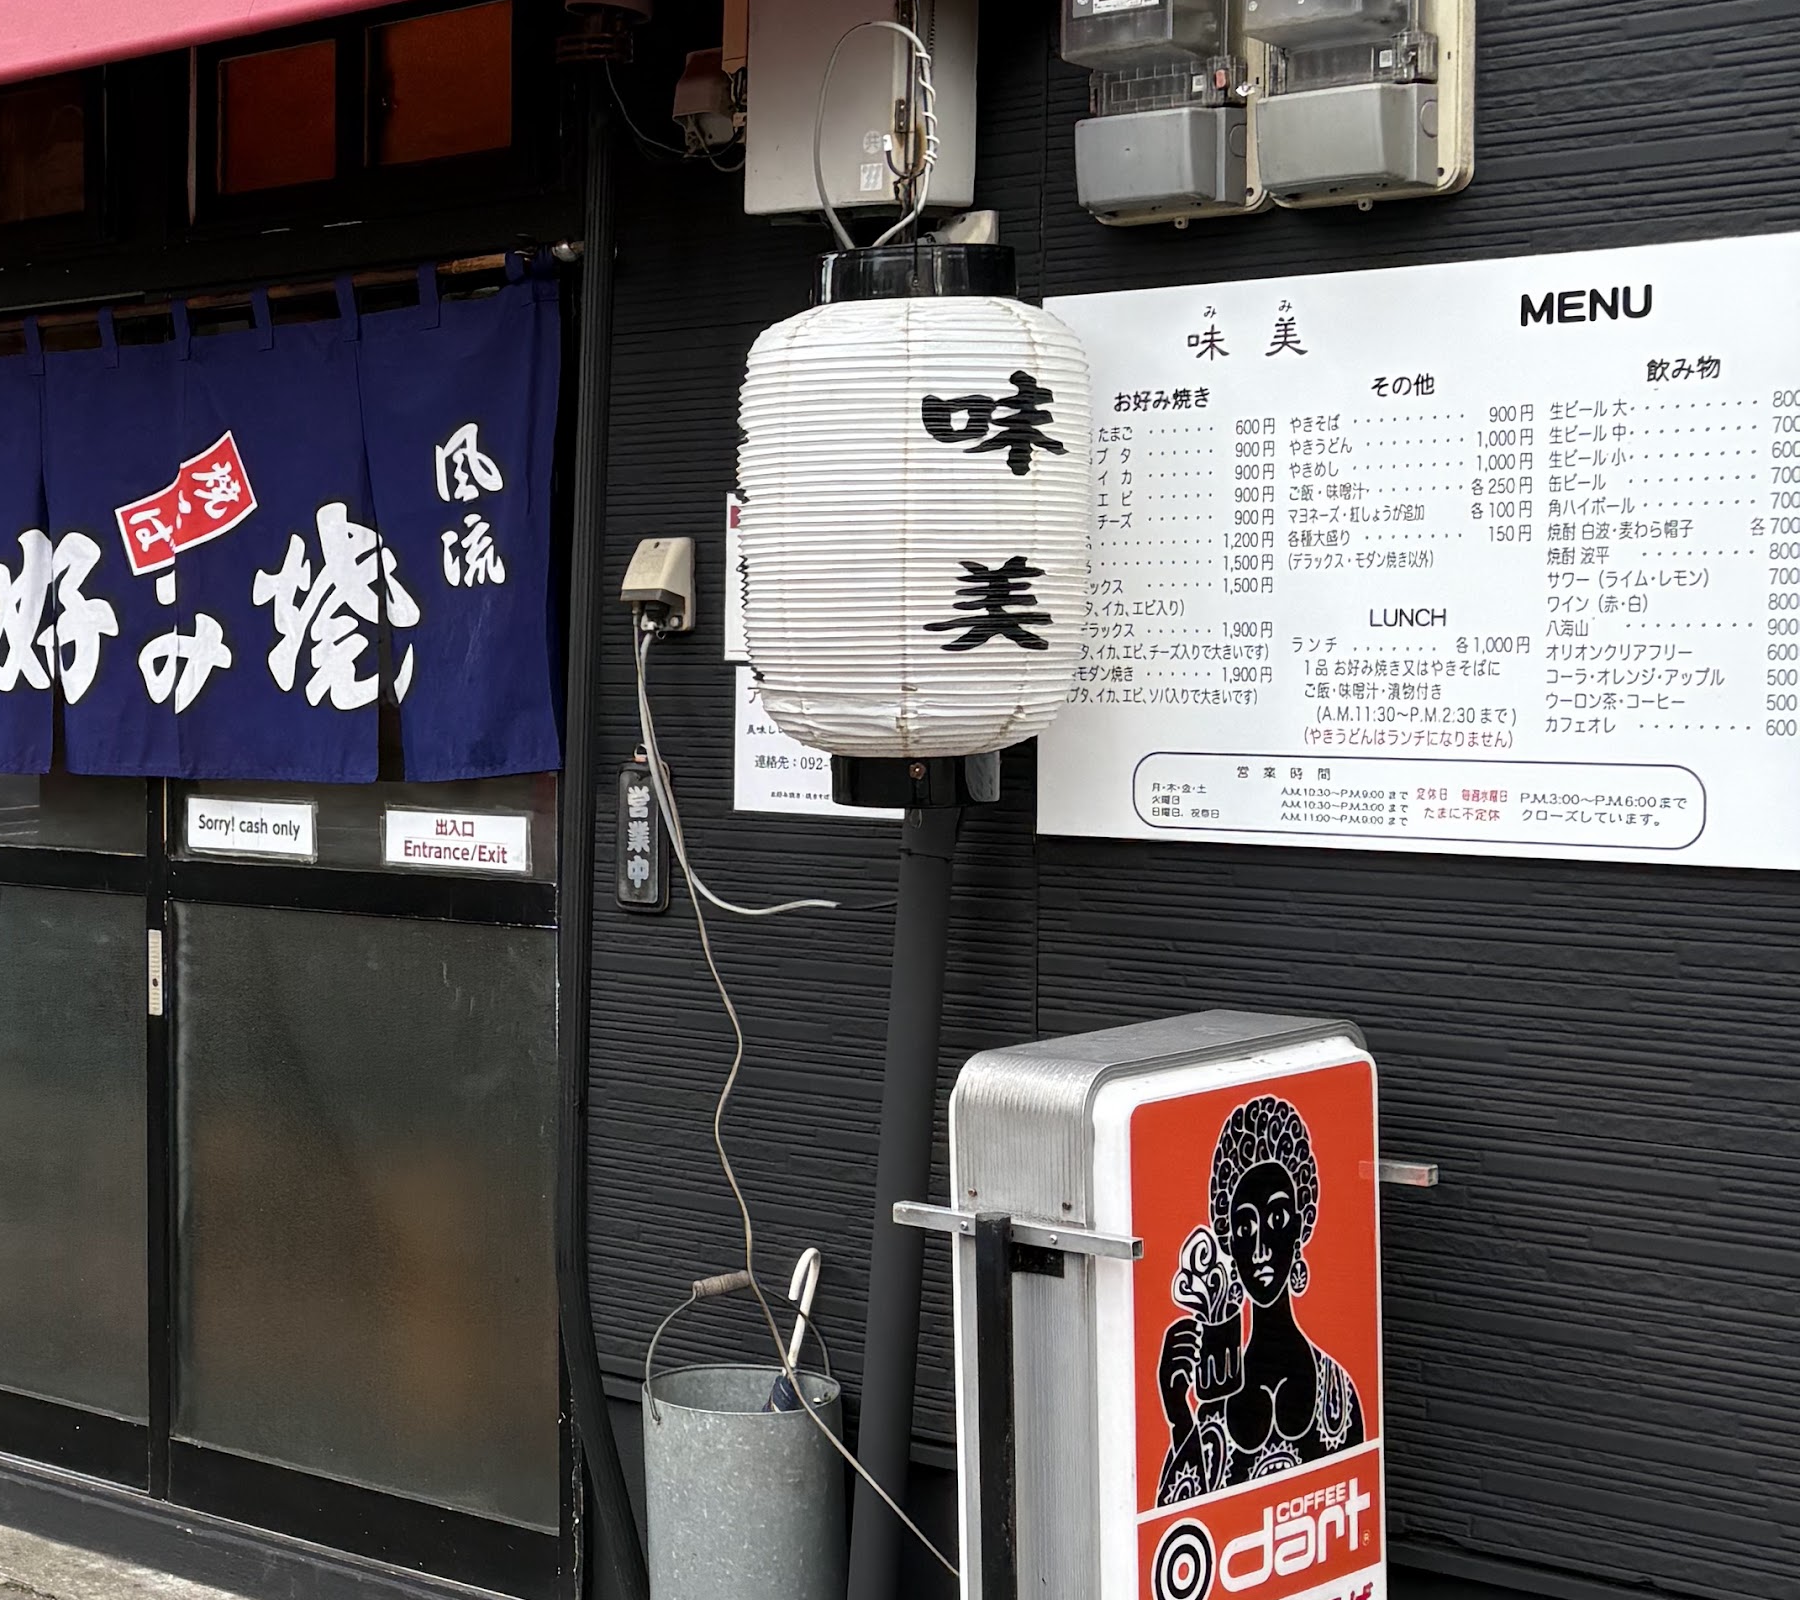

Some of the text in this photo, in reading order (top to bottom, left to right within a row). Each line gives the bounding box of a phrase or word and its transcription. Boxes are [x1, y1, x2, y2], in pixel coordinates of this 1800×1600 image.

[1520, 284, 1653, 327] MENU
[1646, 355, 1721, 382] 飲み物
[1371, 373, 1435, 397] その他
[1114, 387, 1210, 412] お好み焼き
[1290, 404, 1534, 433] やきそば 900円
[1098, 418, 1275, 442] たまご 600円
[1235, 440, 1275, 458] 900円
[1290, 428, 1534, 455] やきうどん 1,000円
[1235, 463, 1274, 480] 900円
[1289, 452, 1533, 478] やきめし 1,000円
[1549, 473, 1606, 493] 缶ビール
[1235, 485, 1274, 503] 900円
[434, 421, 506, 588] 風流
[921, 370, 1068, 653] 味美
[1548, 497, 1635, 517] 角ハイボール
[1097, 508, 1274, 530] チーズ 900円
[1223, 530, 1274, 550] 1,200円
[1287, 524, 1532, 547] 各種大盛り 150円
[1223, 554, 1274, 572] 1,500円
[1082, 576, 1273, 595] ックス 1,500円
[1548, 572, 1589, 589] サワー
[1547, 596, 1589, 613] ワイン
[1369, 608, 1447, 627] LUNCH
[1222, 621, 1273, 639] 1,900円
[1546, 619, 1589, 637] 八海山
[1291, 636, 1337, 653] ランチ
[1546, 644, 1693, 661] オリオンクリアフリー
[1222, 666, 1273, 684] 1,900円
[1546, 667, 1725, 686] コーラ・オレンジ・アップル
[1546, 693, 1685, 710] ウーロン茶・コーヒー
[1545, 717, 1616, 734] カフェオレ
[1416, 788, 1448, 801] 定休日
[1424, 807, 1501, 821] たまに不定休
[1521, 809, 1661, 827] クローズしています。
[198, 814, 300, 840] Sorry! cash only
[435, 818, 475, 838] 出入口
[627, 785, 651, 889] 営業中
[403, 840, 508, 864] Entrance/Exit
[1276, 1482, 1346, 1524] COFFEE
[1219, 1473, 1371, 1593] dart
